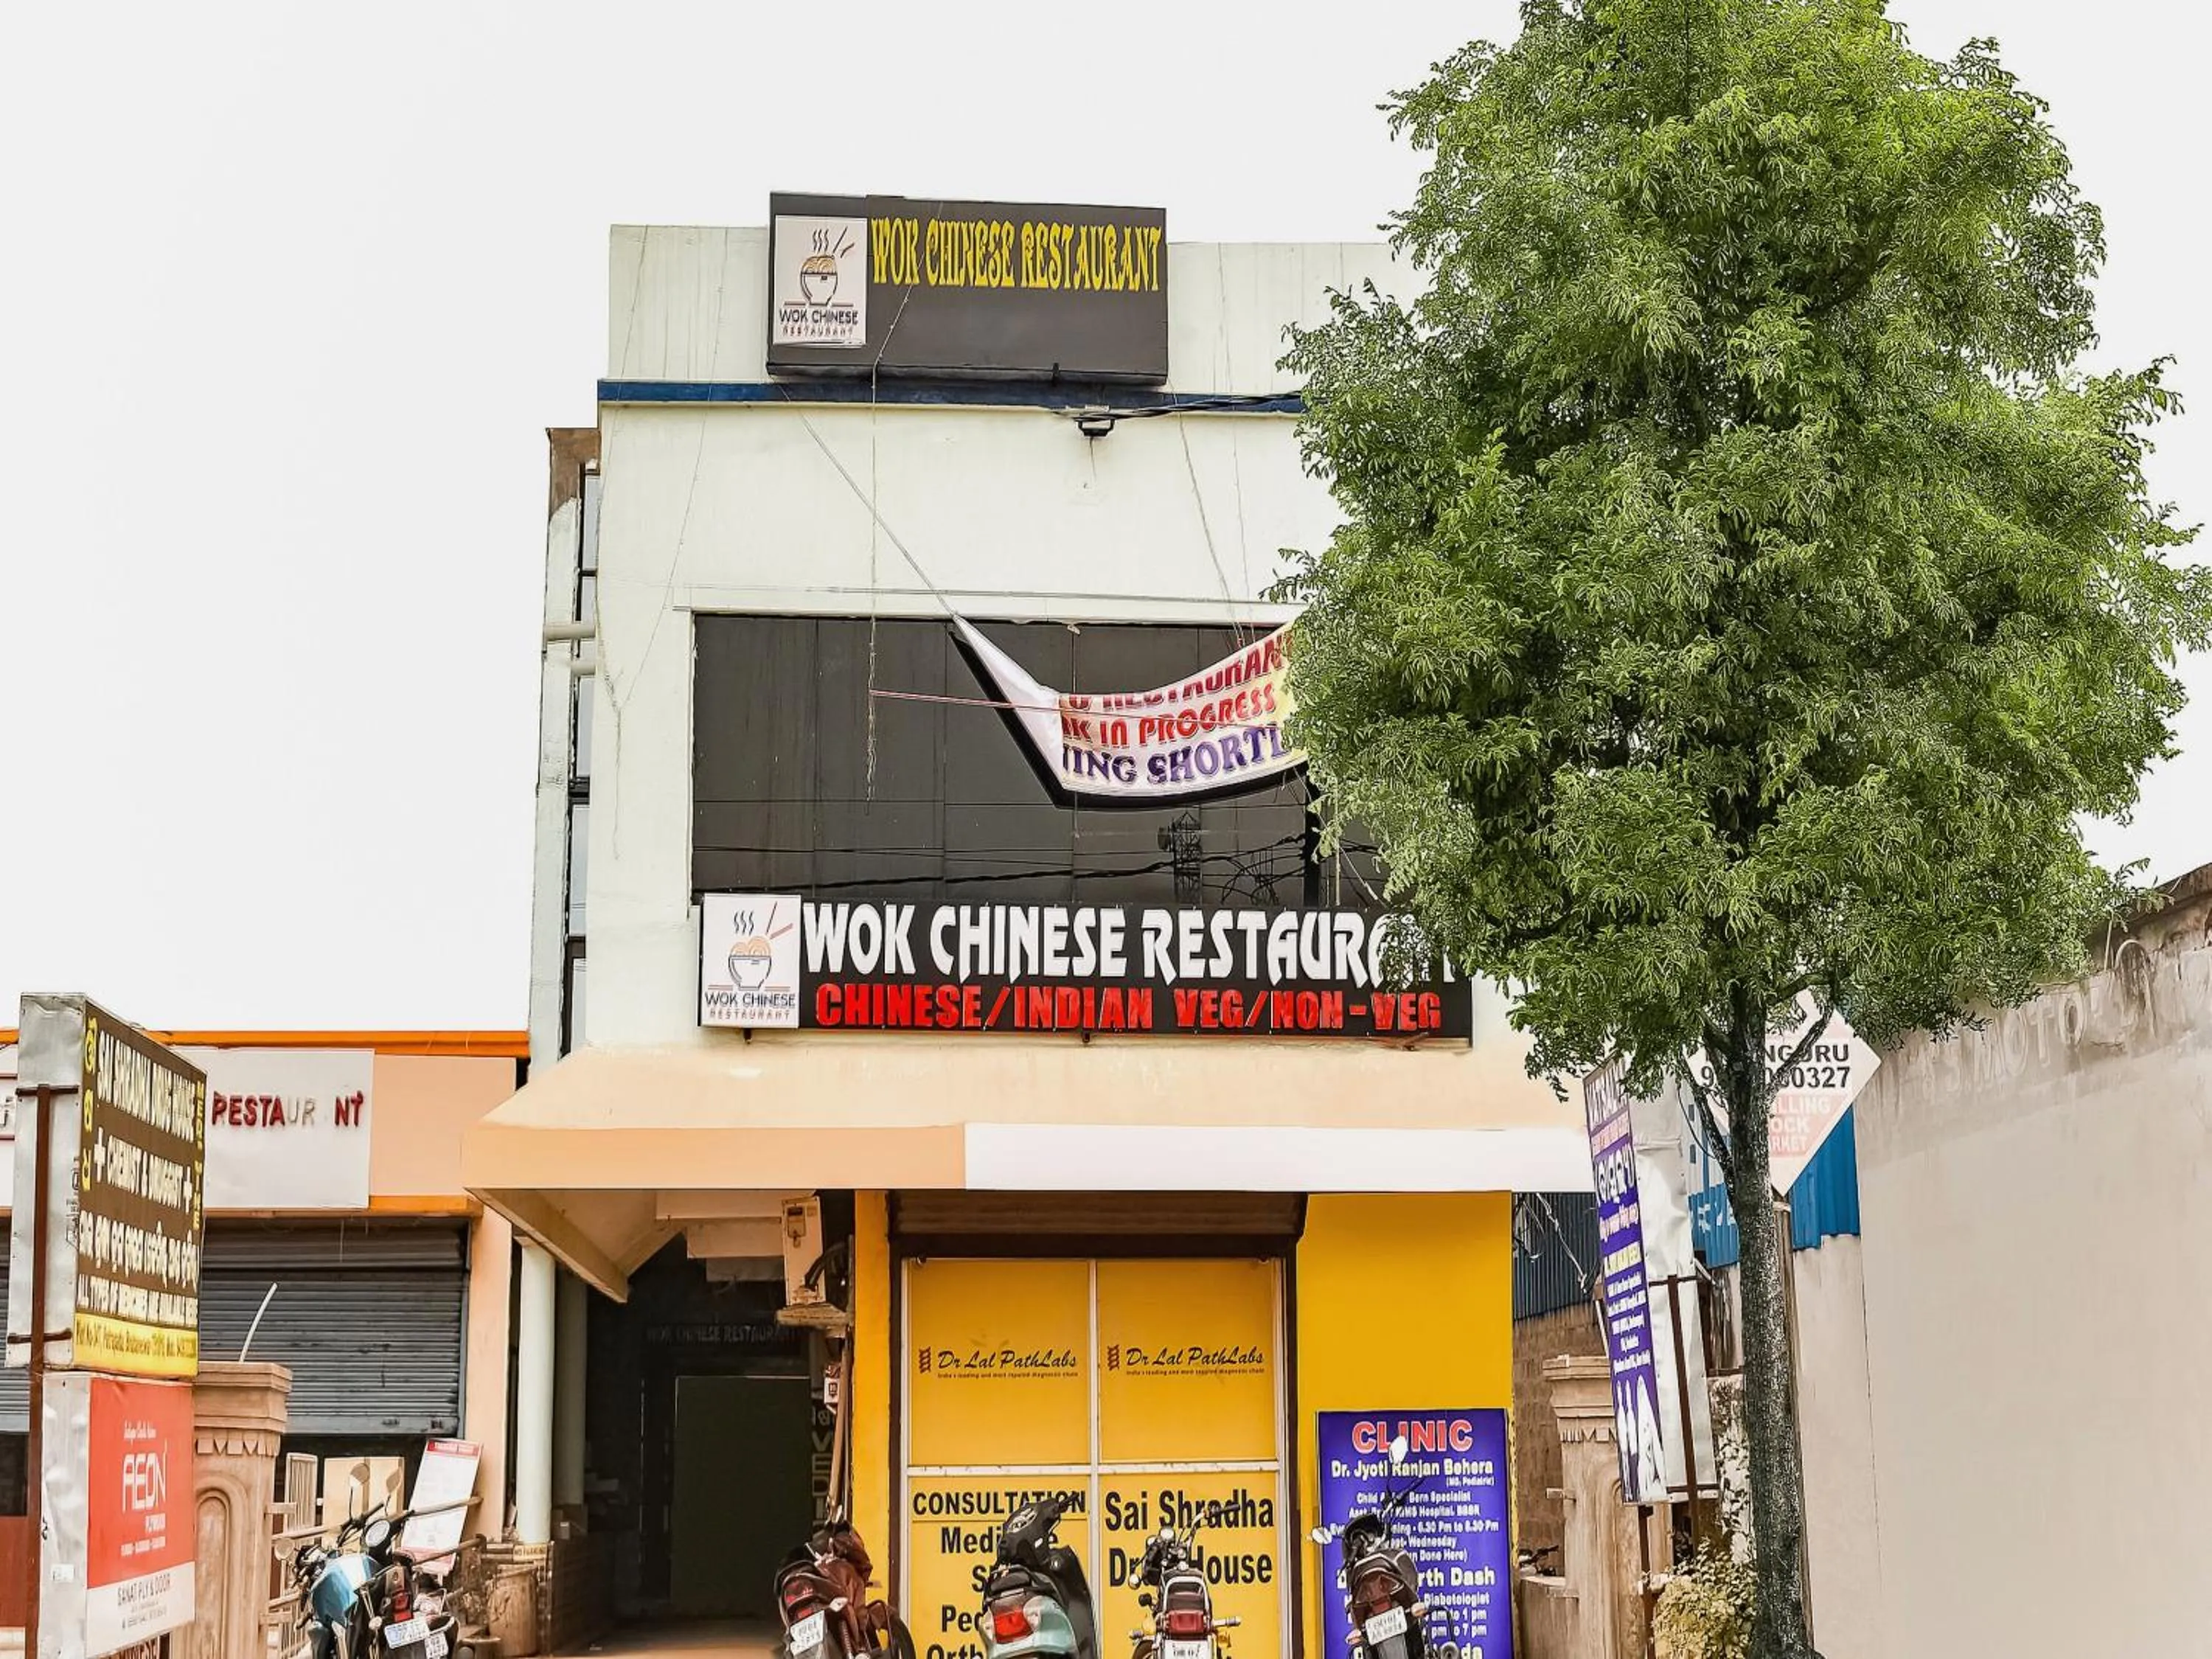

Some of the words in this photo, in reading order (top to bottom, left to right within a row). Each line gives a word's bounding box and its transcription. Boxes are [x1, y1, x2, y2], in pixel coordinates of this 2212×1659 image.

[871, 218, 920, 285] WOK
[926, 219, 1015, 288] CHINESE
[1020, 222, 1161, 292] RESTAURANT
[779, 308, 808, 324] WOK
[812, 309, 858, 324] CHINESE
[1139, 683, 1276, 747] PROGRESS
[803, 902, 917, 975] WOK
[930, 905, 1127, 984] CHINESE
[705, 992, 738, 1007] WOK
[742, 993, 796, 1009] CHINESE
[938, 1351, 961, 1368] Dr
[964, 1350, 996, 1368] Lal
[1000, 1349, 1077, 1369] PathLabs
[1126, 1348, 1149, 1366] Dr
[1152, 1347, 1183, 1366] Lal
[1188, 1346, 1263, 1366] PathLabs
[1332, 1460, 1349, 1478] Dr.
[1354, 1460, 1388, 1481] Jyoti
[1392, 1459, 1440, 1478] Ranjan
[1443, 1458, 1493, 1475] Behera
[1357, 1492, 1377, 1503] Child
[1409, 1492, 1427, 1503] Born
[1430, 1491, 1470, 1503] Specialist
[1105, 1491, 1147, 1531] Sai
[1158, 1489, 1274, 1528] Shradha
[1439, 1520, 1452, 1532] Pm
[1454, 1521, 1464, 1532] to
[1485, 1520, 1499, 1531] Pm
[942, 1527, 1057, 1554] Medie
[1408, 1535, 1457, 1549] Wednesday
[1419, 1549, 1441, 1561] Done
[1444, 1548, 1467, 1562] Here)
[1450, 1566, 1495, 1587] Dash
[1471, 1609, 1487, 1623] pm
[1431, 1626, 1447, 1639] pm
[1462, 1623, 1470, 1636] 7
[1471, 1624, 1487, 1638] pm
